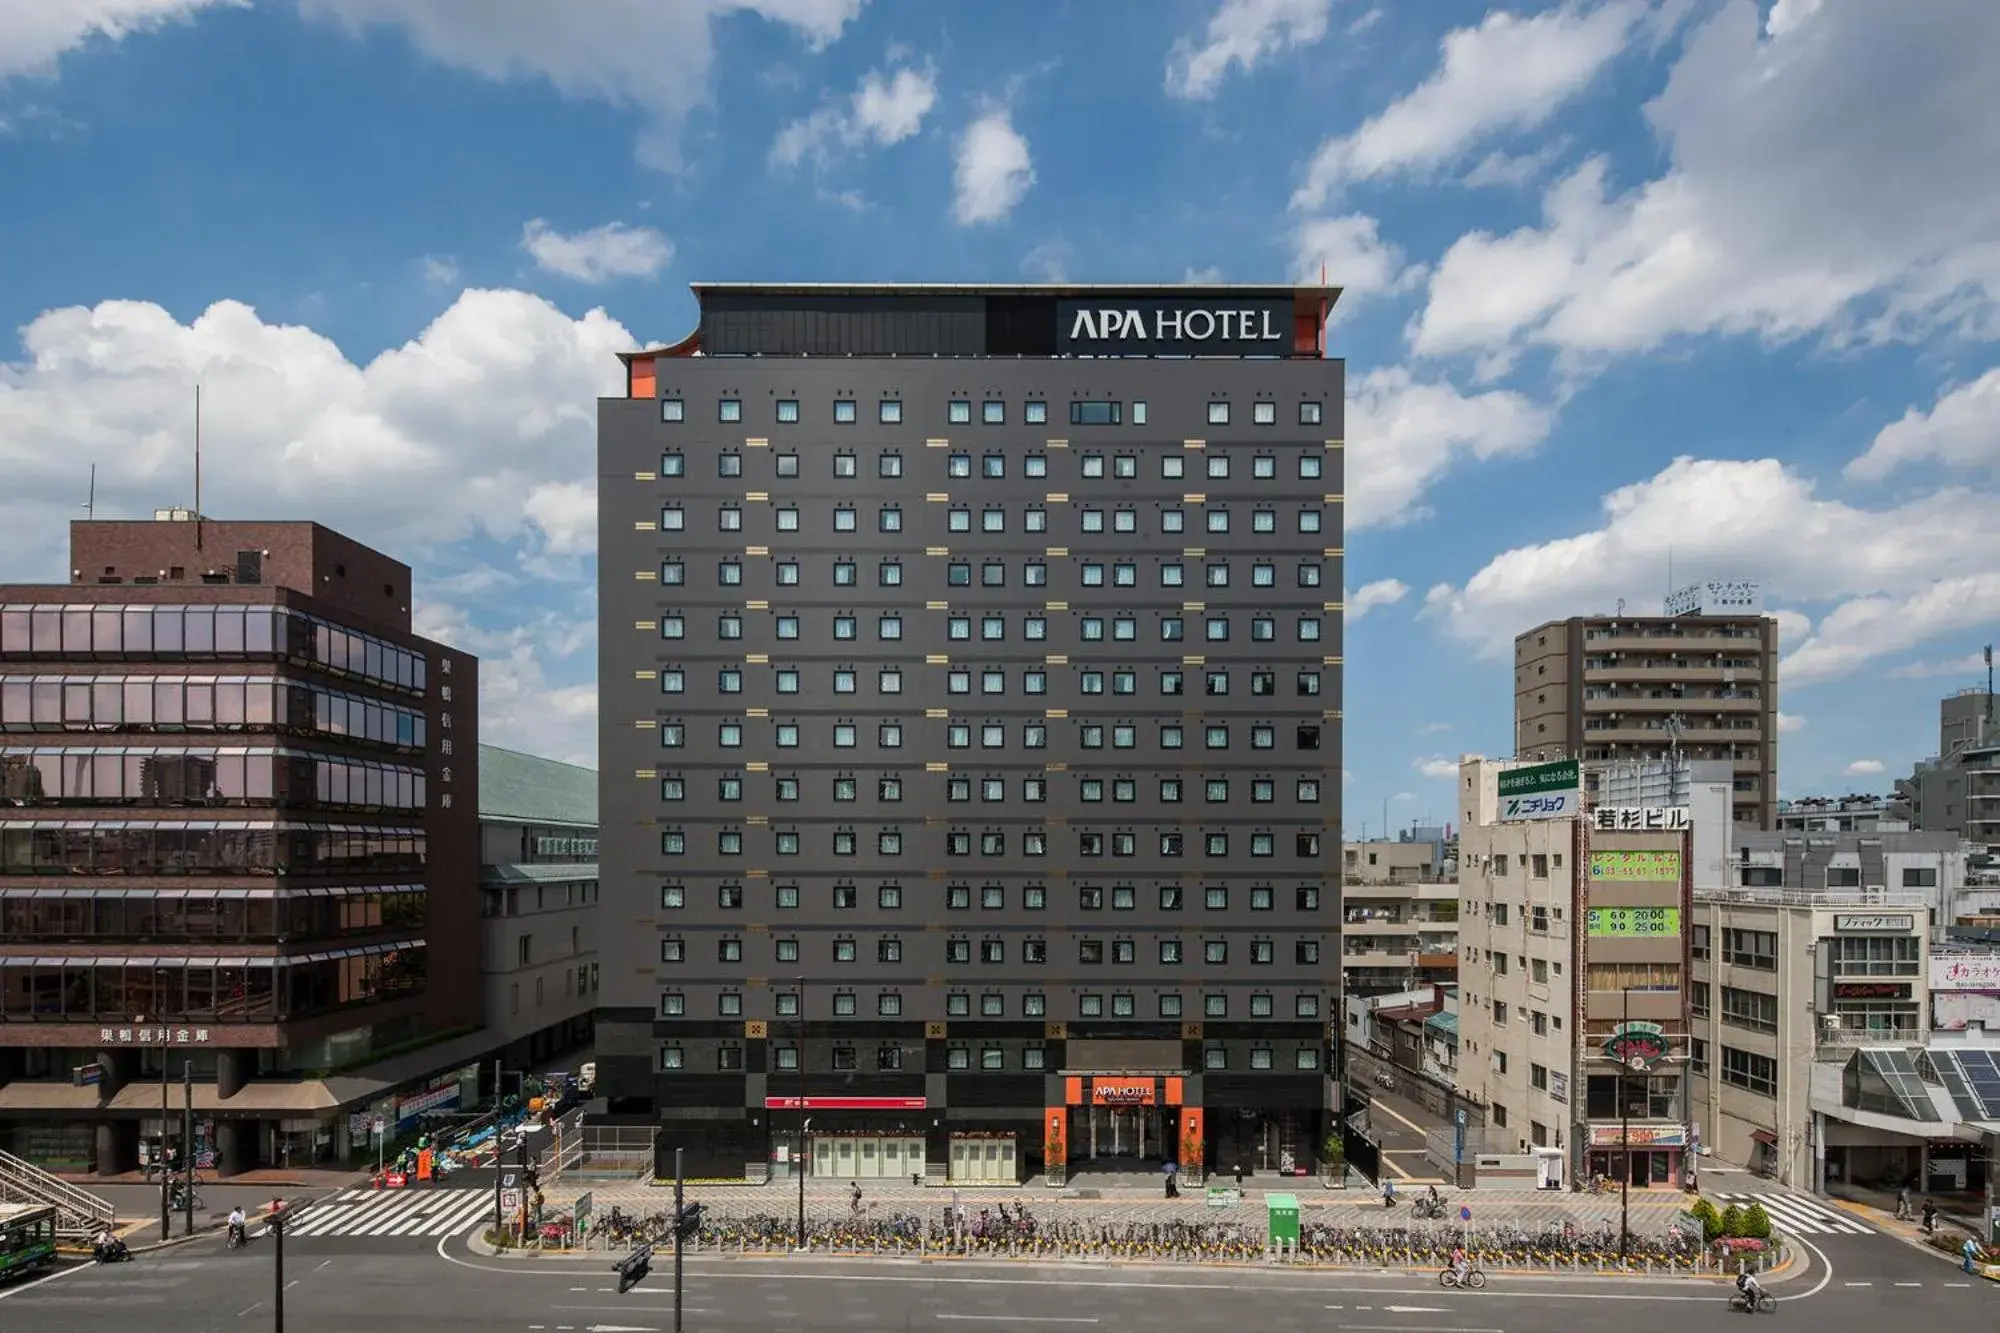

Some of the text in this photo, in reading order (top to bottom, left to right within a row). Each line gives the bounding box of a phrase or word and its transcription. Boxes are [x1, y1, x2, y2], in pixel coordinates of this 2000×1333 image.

[1070, 309, 1281, 340] APA HOTEL
[1597, 808, 1688, 828] 若杉ビル
[100, 1028, 209, 1042] 巣鴨信用金庫
[1095, 1086, 1153, 1096] APA HOTEL
